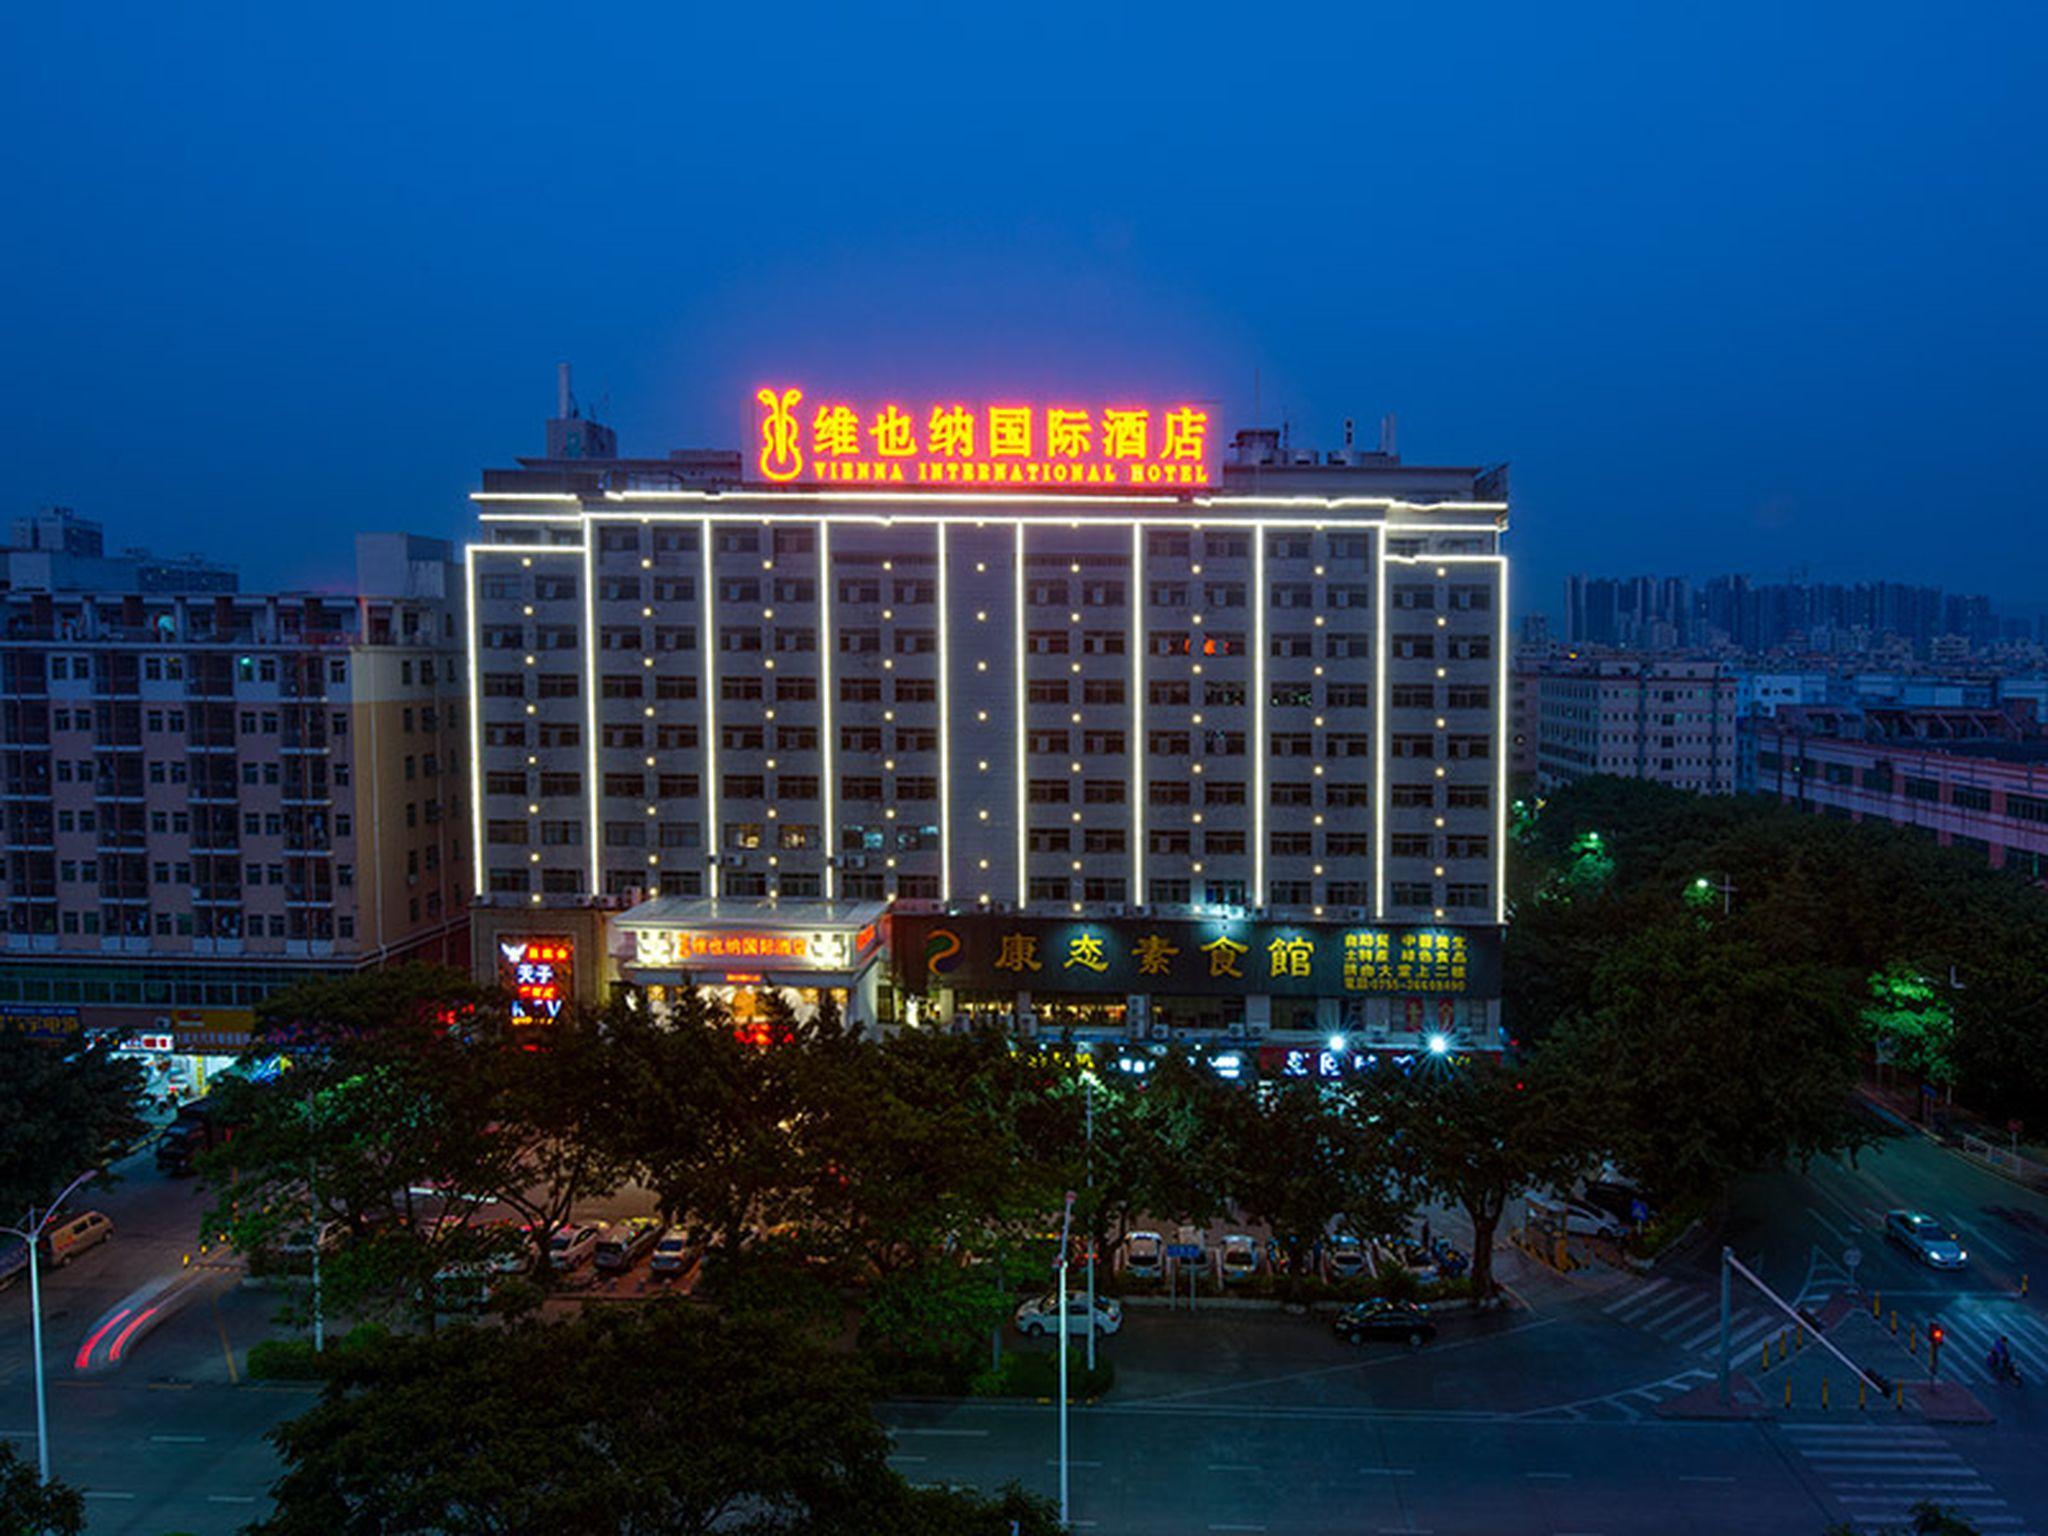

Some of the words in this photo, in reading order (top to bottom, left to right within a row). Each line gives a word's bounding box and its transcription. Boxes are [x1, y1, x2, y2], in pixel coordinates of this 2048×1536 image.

[813, 405, 1207, 460] 维也纳国际酒店
[813, 461, 904, 481] VIENNA
[919, 462, 1117, 483] INTERNATIONAL
[1131, 463, 1207, 484] HOTEL
